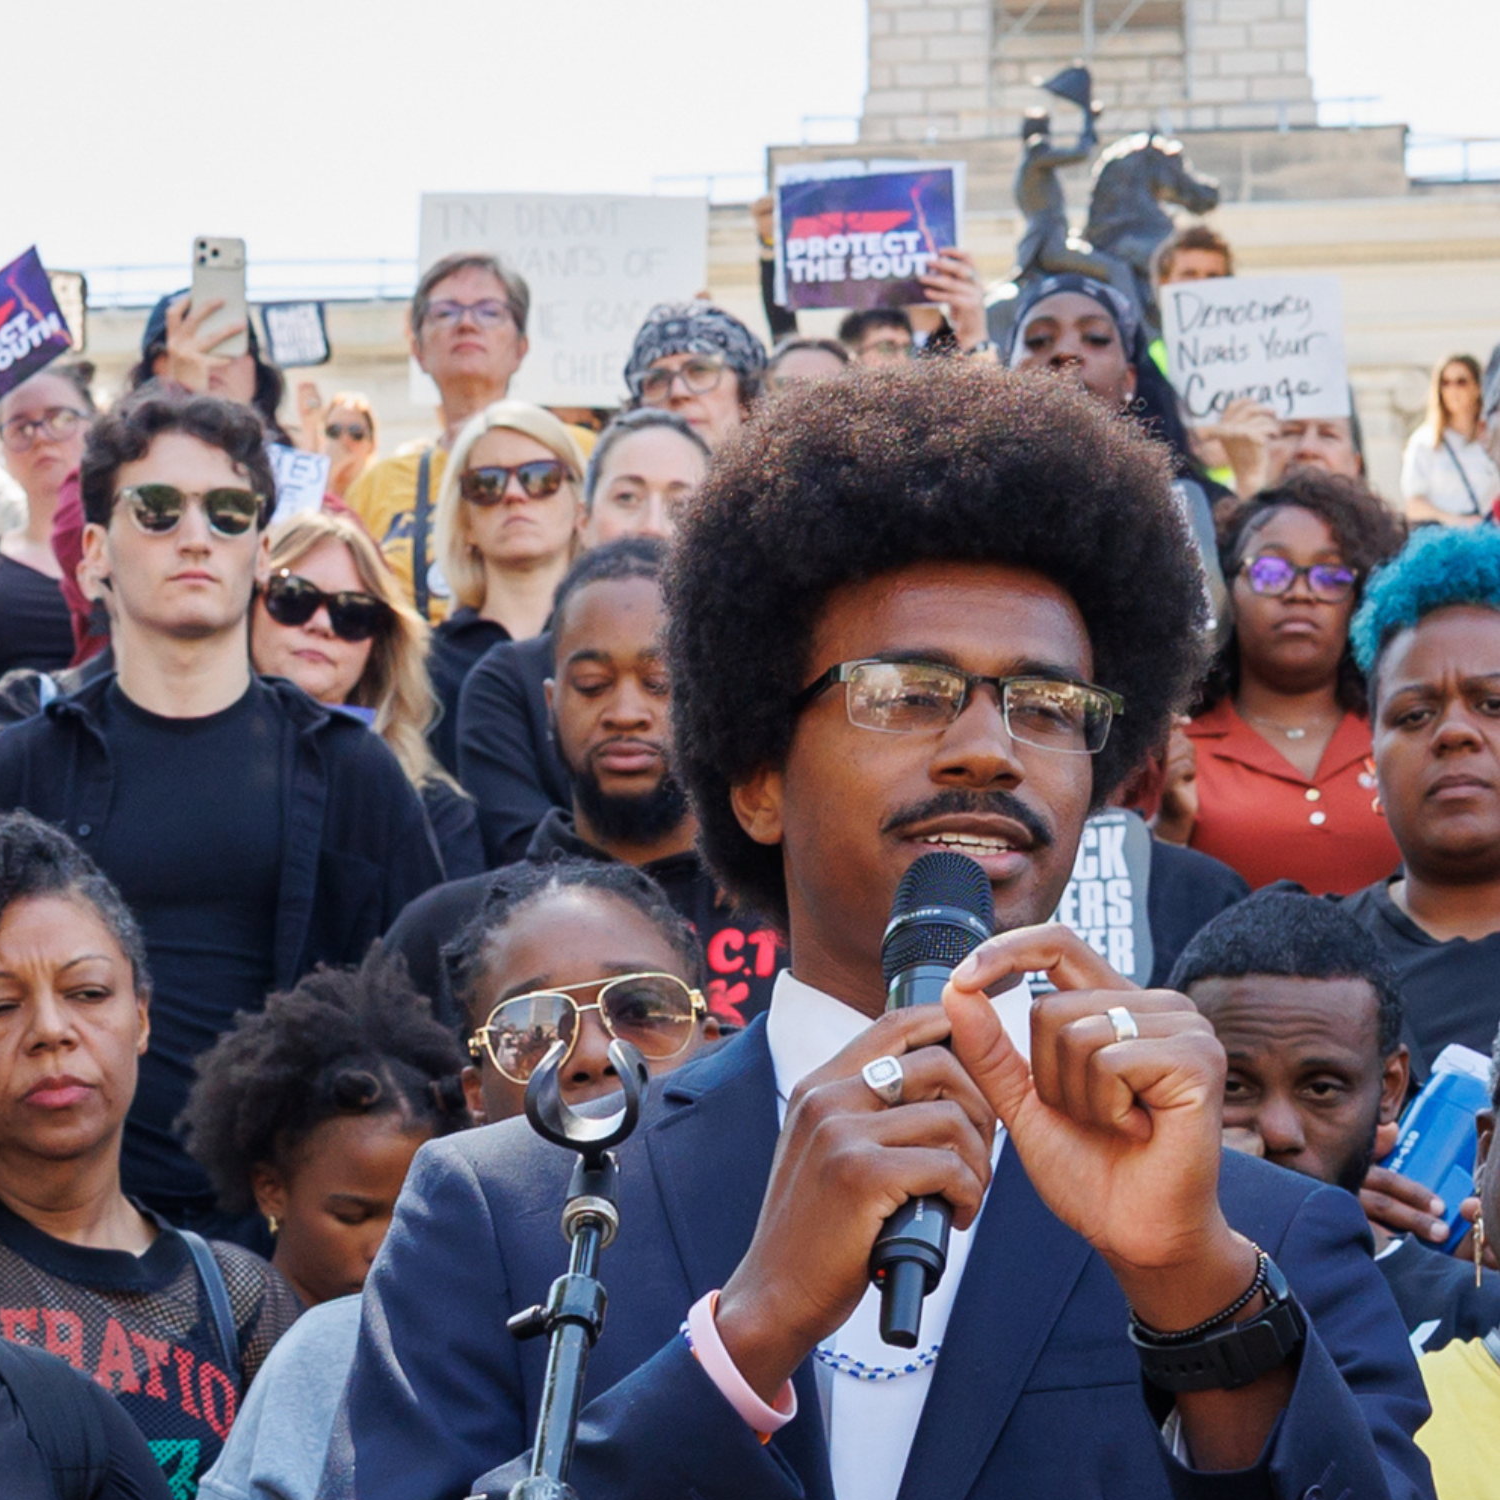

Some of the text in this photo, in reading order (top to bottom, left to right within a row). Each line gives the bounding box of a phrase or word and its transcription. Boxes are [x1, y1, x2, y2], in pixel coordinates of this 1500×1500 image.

[786, 230, 921, 260] PROTECT
[786, 252, 938, 283] THE SOUT
[1258, 326, 1329, 362] Your
